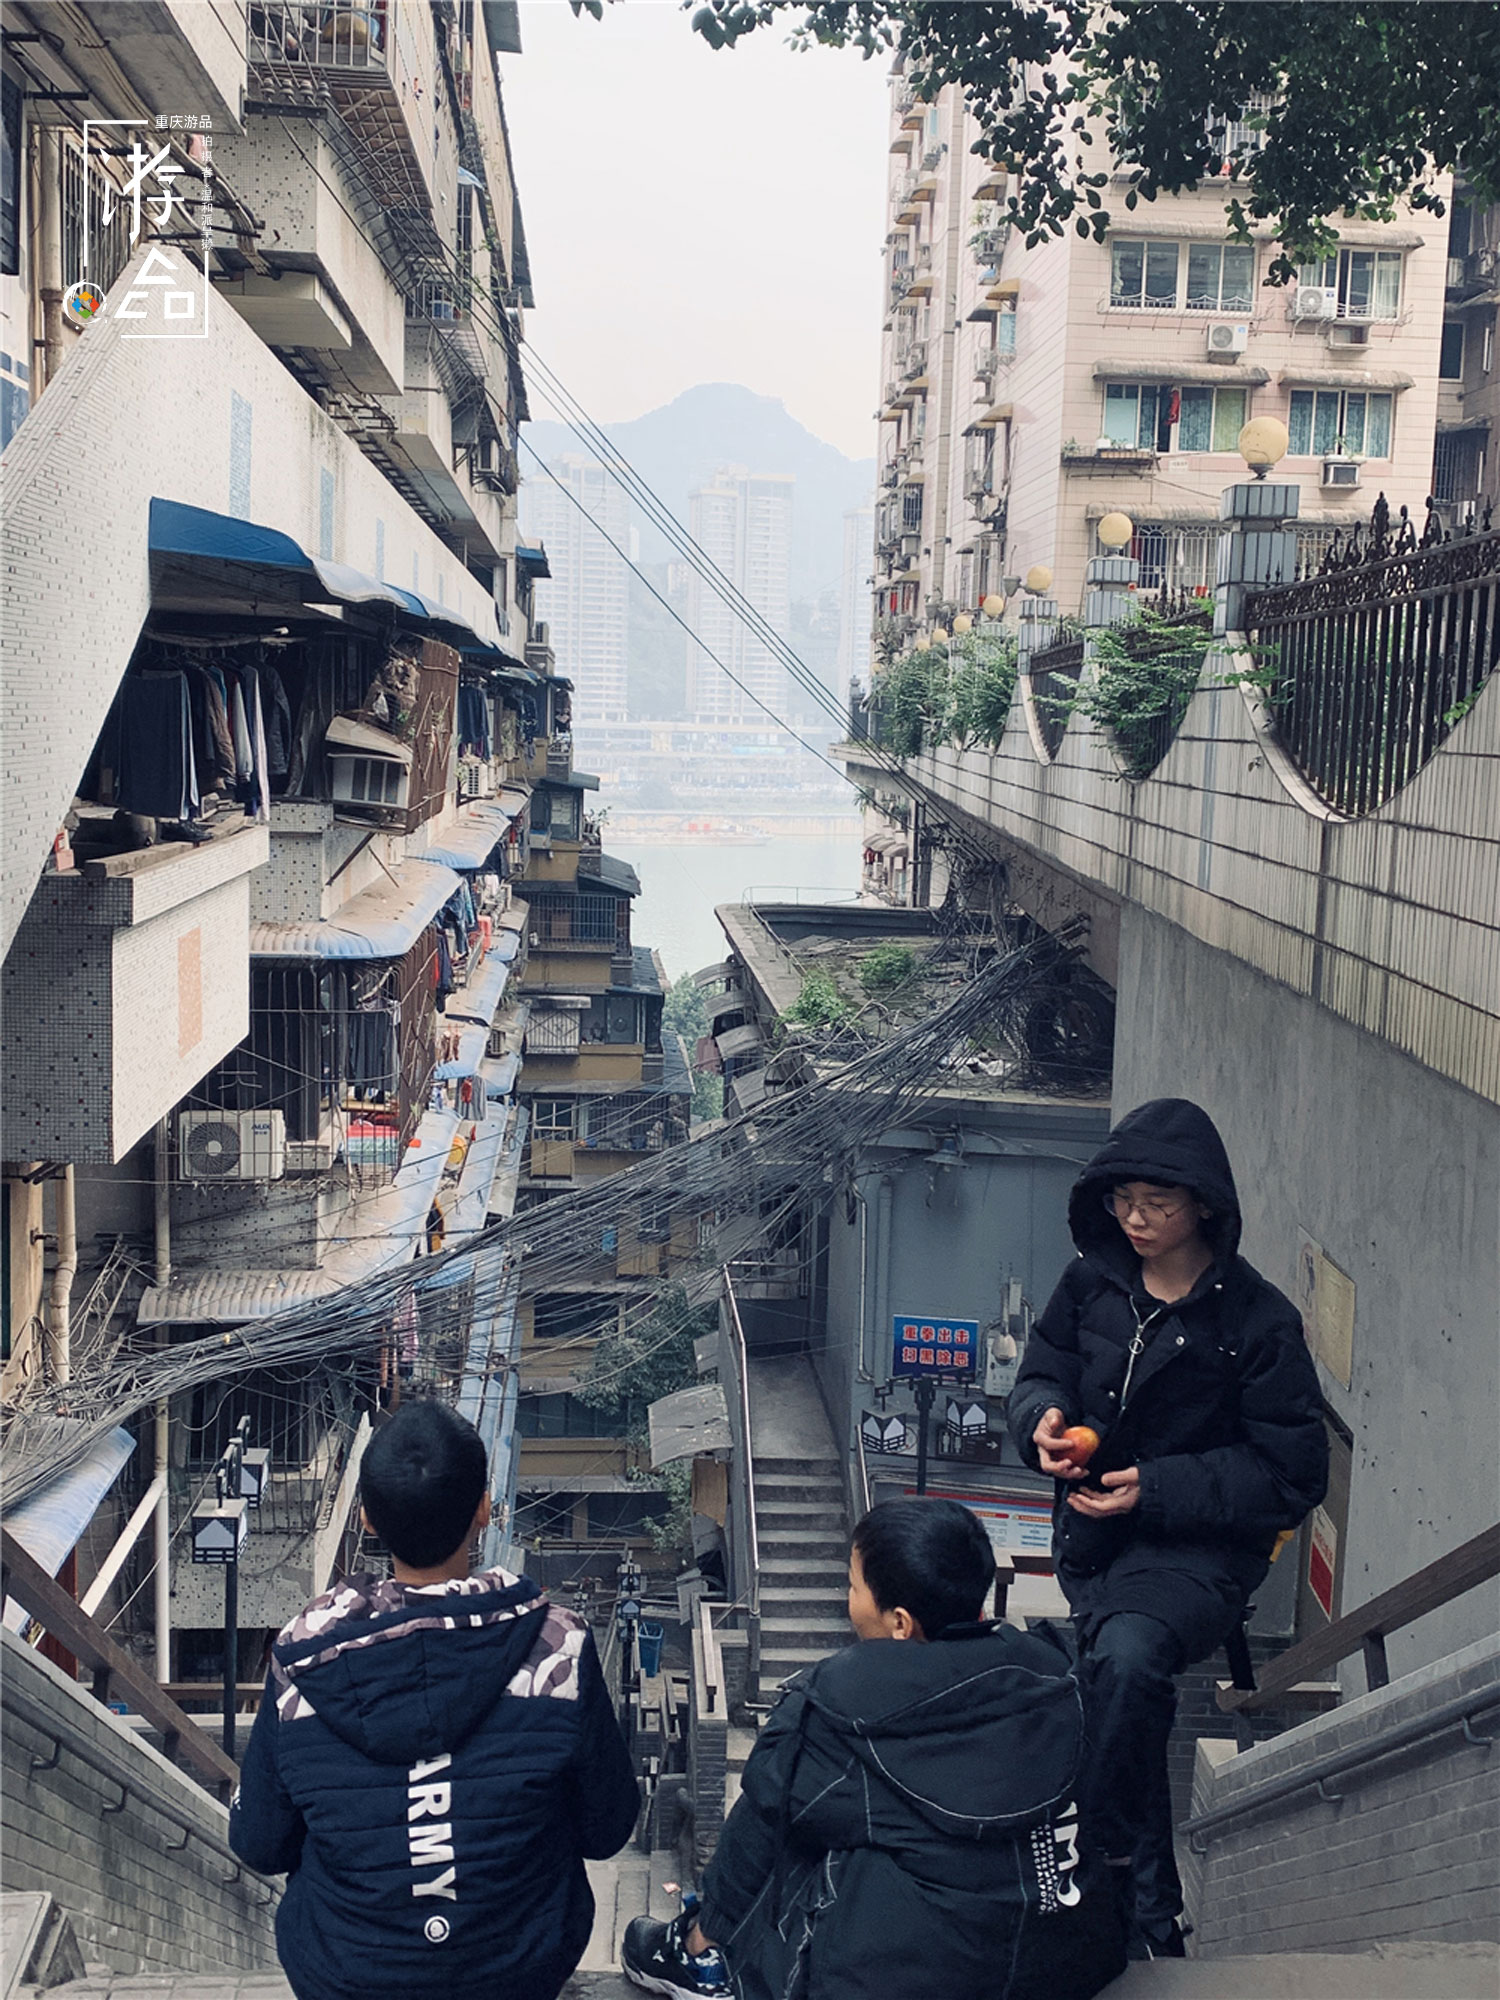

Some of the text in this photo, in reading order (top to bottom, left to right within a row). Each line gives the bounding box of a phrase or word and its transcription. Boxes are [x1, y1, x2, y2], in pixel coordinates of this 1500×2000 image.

[903, 1324, 969, 1345] 重拳出击
[902, 1346, 969, 1368] 扫黑除恶
